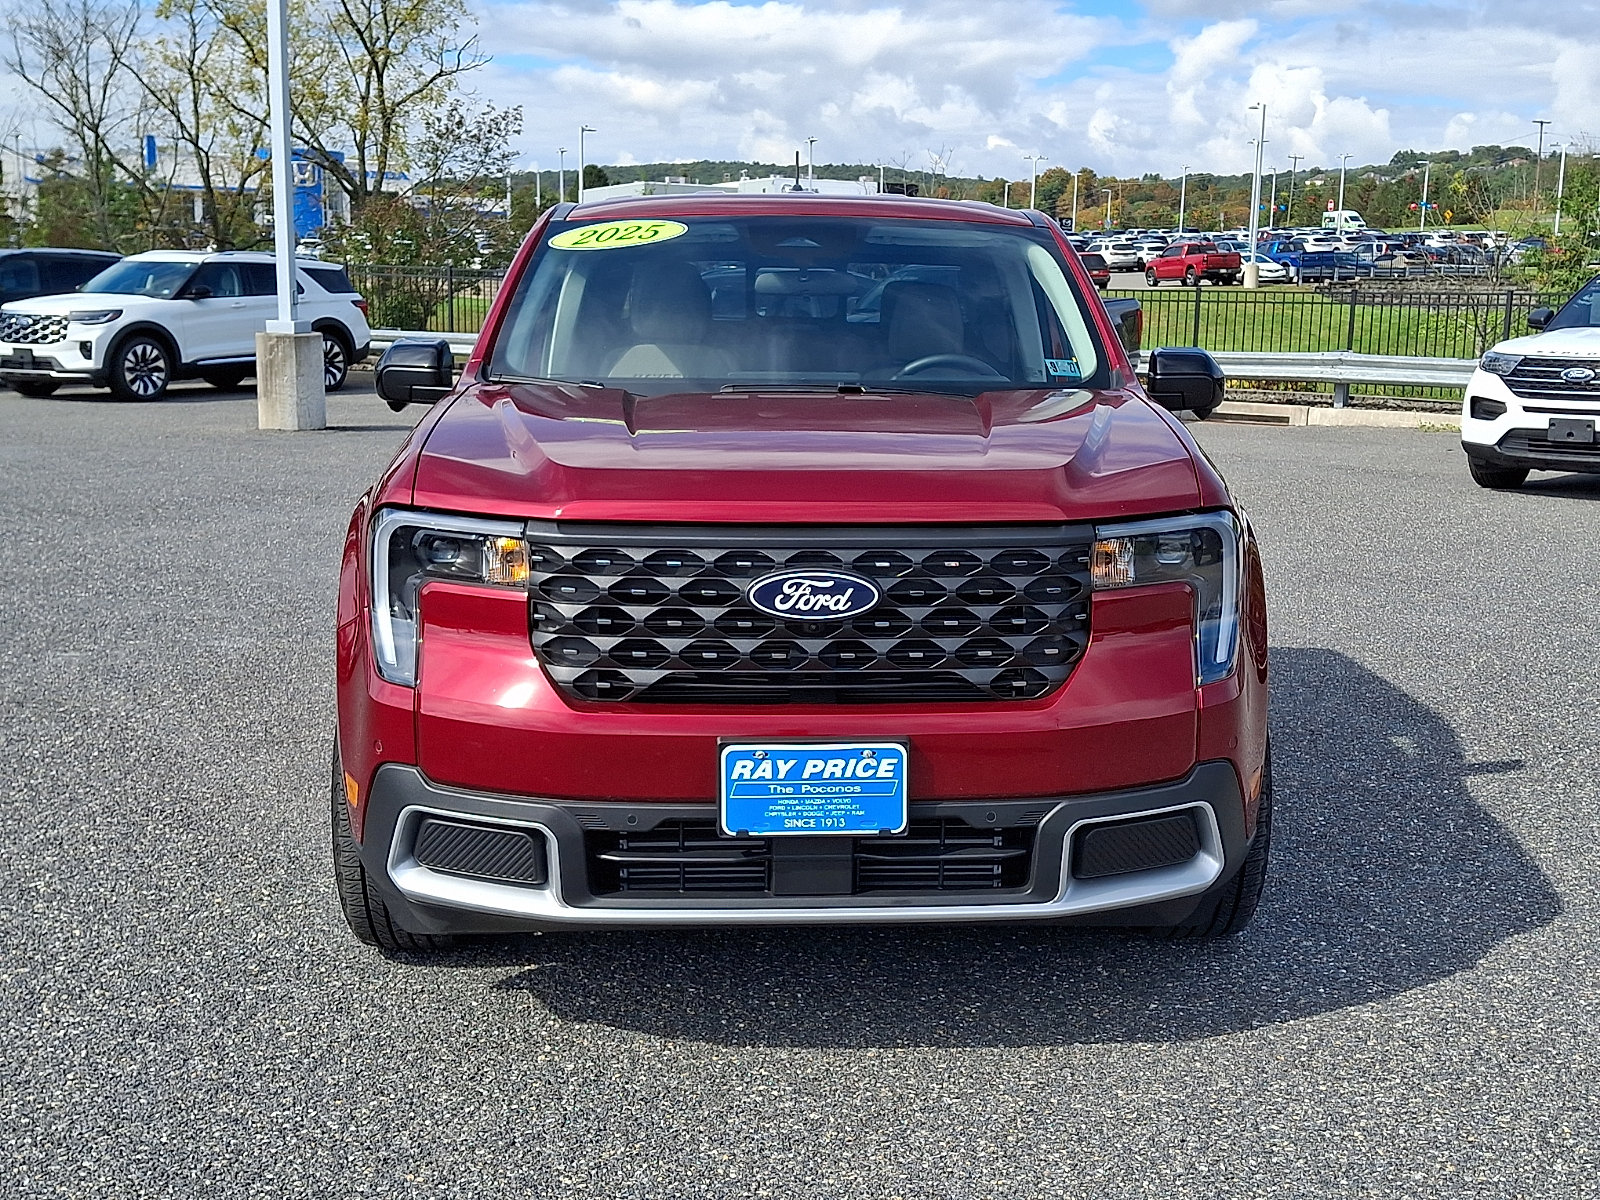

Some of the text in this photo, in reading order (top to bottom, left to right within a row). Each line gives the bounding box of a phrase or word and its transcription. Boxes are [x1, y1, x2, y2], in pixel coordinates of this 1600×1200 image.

[571, 224, 666, 246] 2025
[774, 578, 854, 611] Ford
[731, 758, 899, 780] RAY PRICE
[768, 785, 862, 795] The Poconos
[784, 818, 846, 828] SINCE 1913
